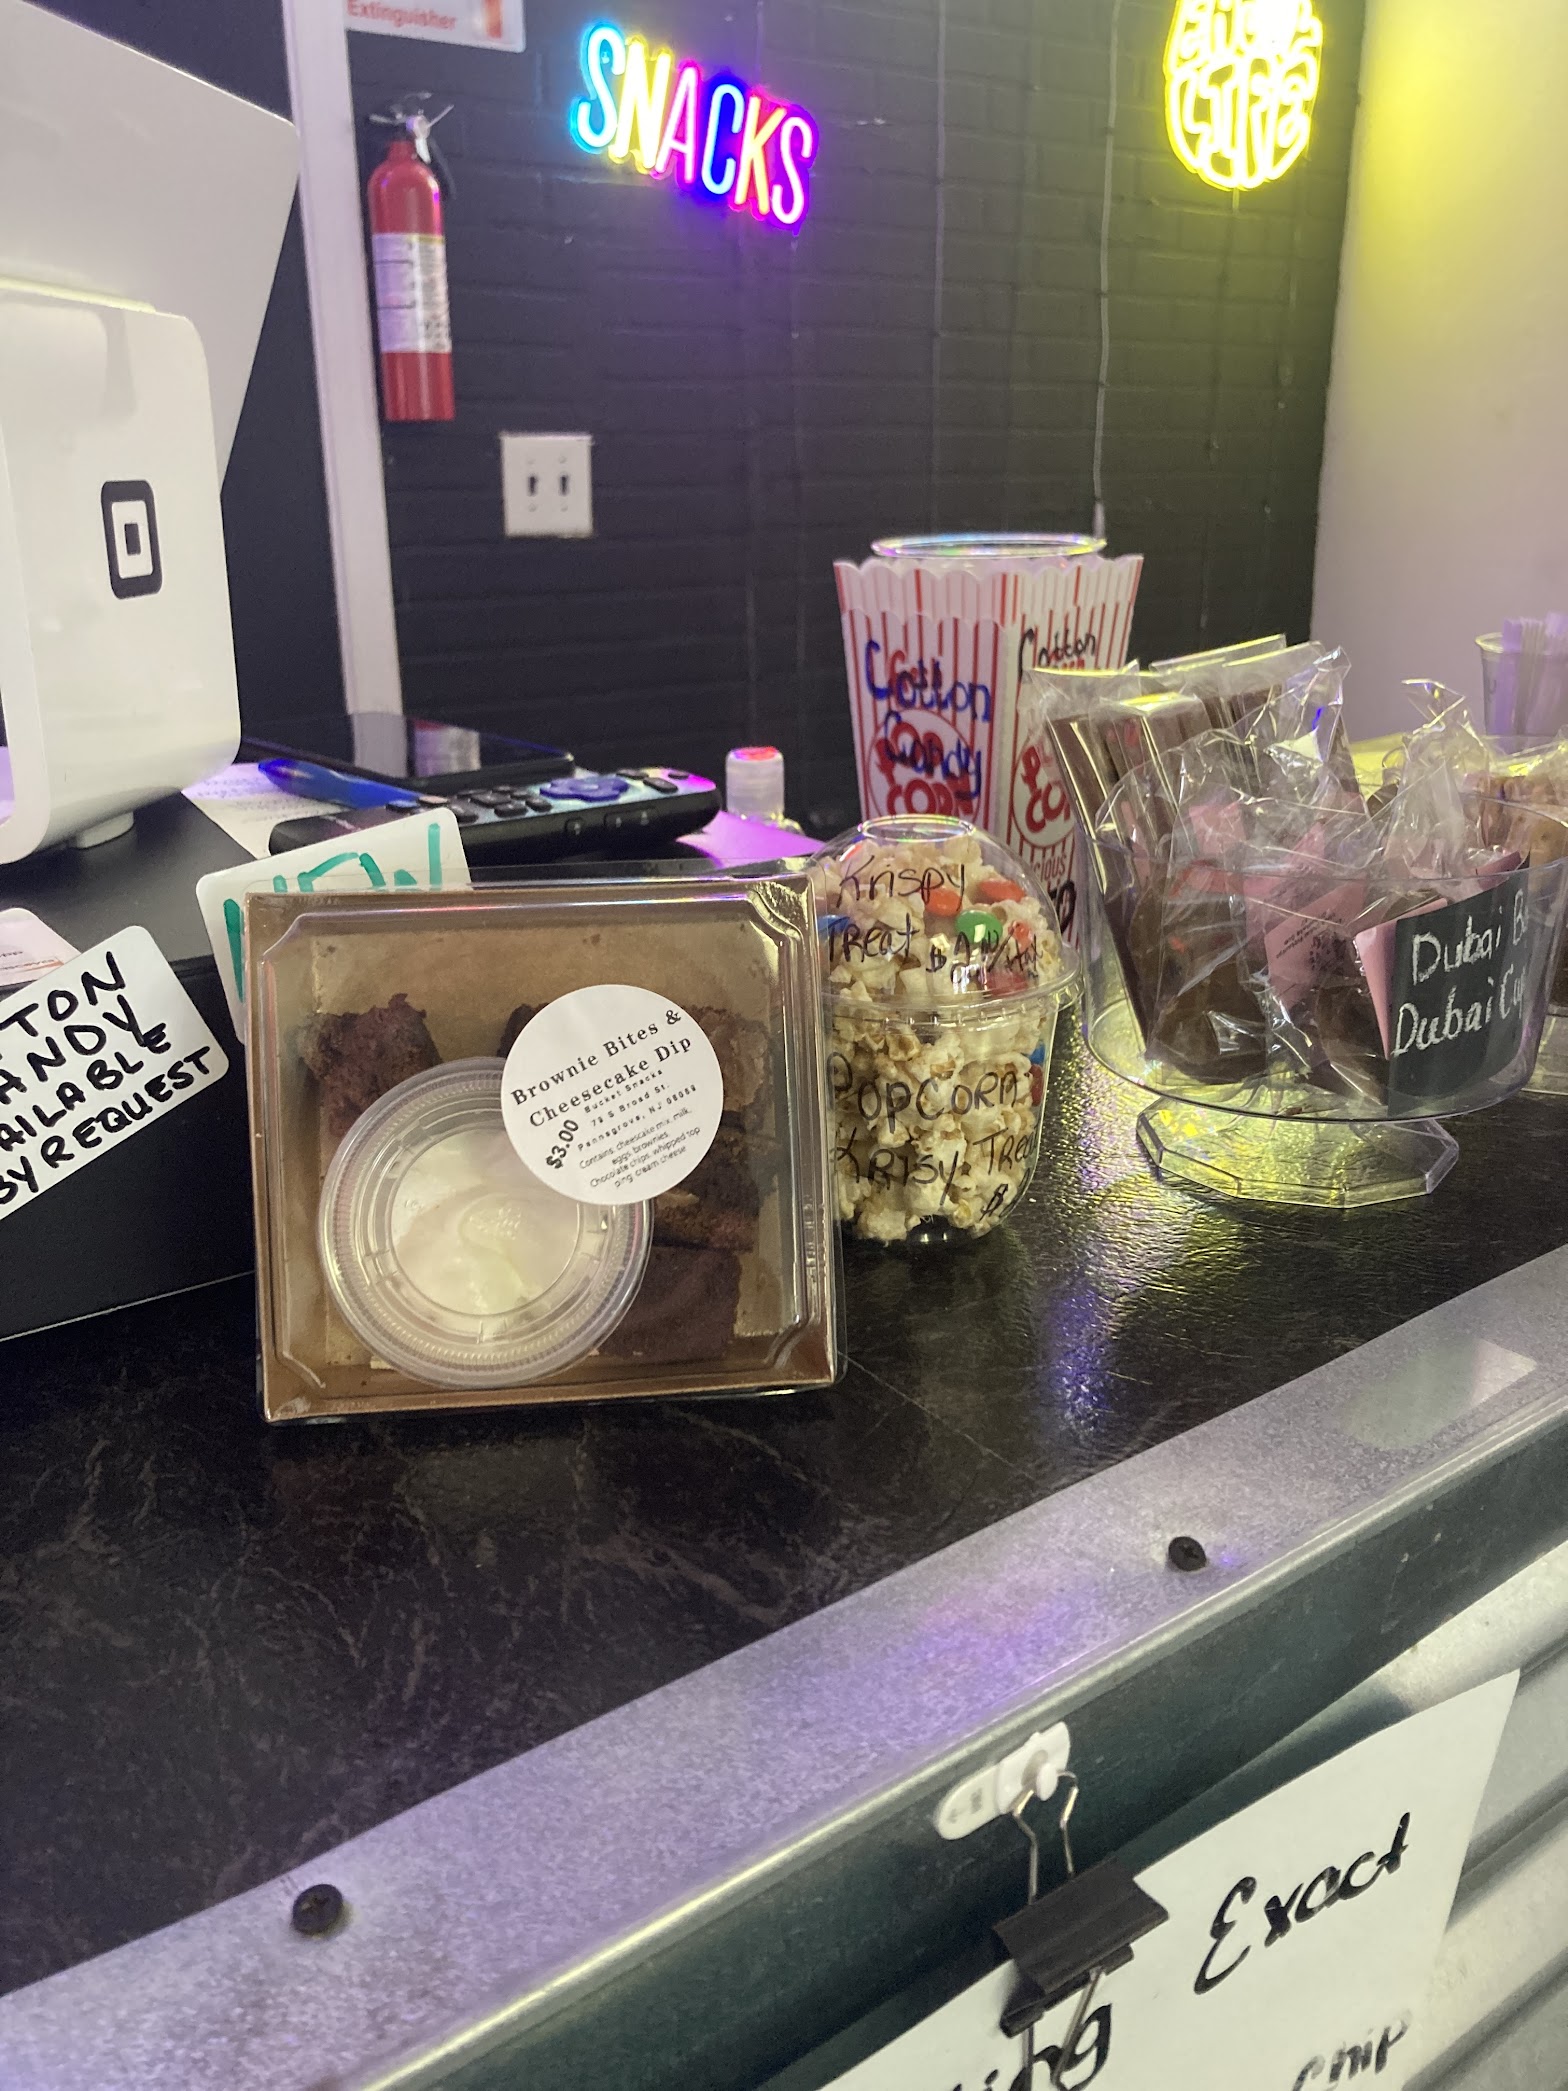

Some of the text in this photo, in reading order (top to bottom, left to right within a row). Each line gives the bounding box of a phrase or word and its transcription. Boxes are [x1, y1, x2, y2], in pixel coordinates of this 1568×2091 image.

[348, 2, 456, 31] Extinguisher
[576, 25, 814, 226] SNACKS
[866, 640, 991, 723] Cotton
[1412, 906, 1503, 986] Dubai
[0, 994, 146, 1105] ANDY
[1393, 977, 1494, 1057] Dubai
[510, 1009, 682, 1106] Brownie Bites &
[530, 1035, 692, 1127] Cheesecake Dip
[584, 1070, 662, 1113] Bucket Snacks
[41, 1046, 210, 1168] REQUEST
[619, 1092, 650, 1112] Broad
[648, 1102, 662, 1114] NJ
[546, 1119, 579, 1170] $3.00
[590, 1164, 629, 1187] Chocolate
[652, 1133, 686, 1155] whipped
[686, 1127, 700, 1137] top
[635, 1160, 659, 1177] cream
[660, 1146, 686, 1163] cheese
[1195, 1812, 1411, 1995] Exact
